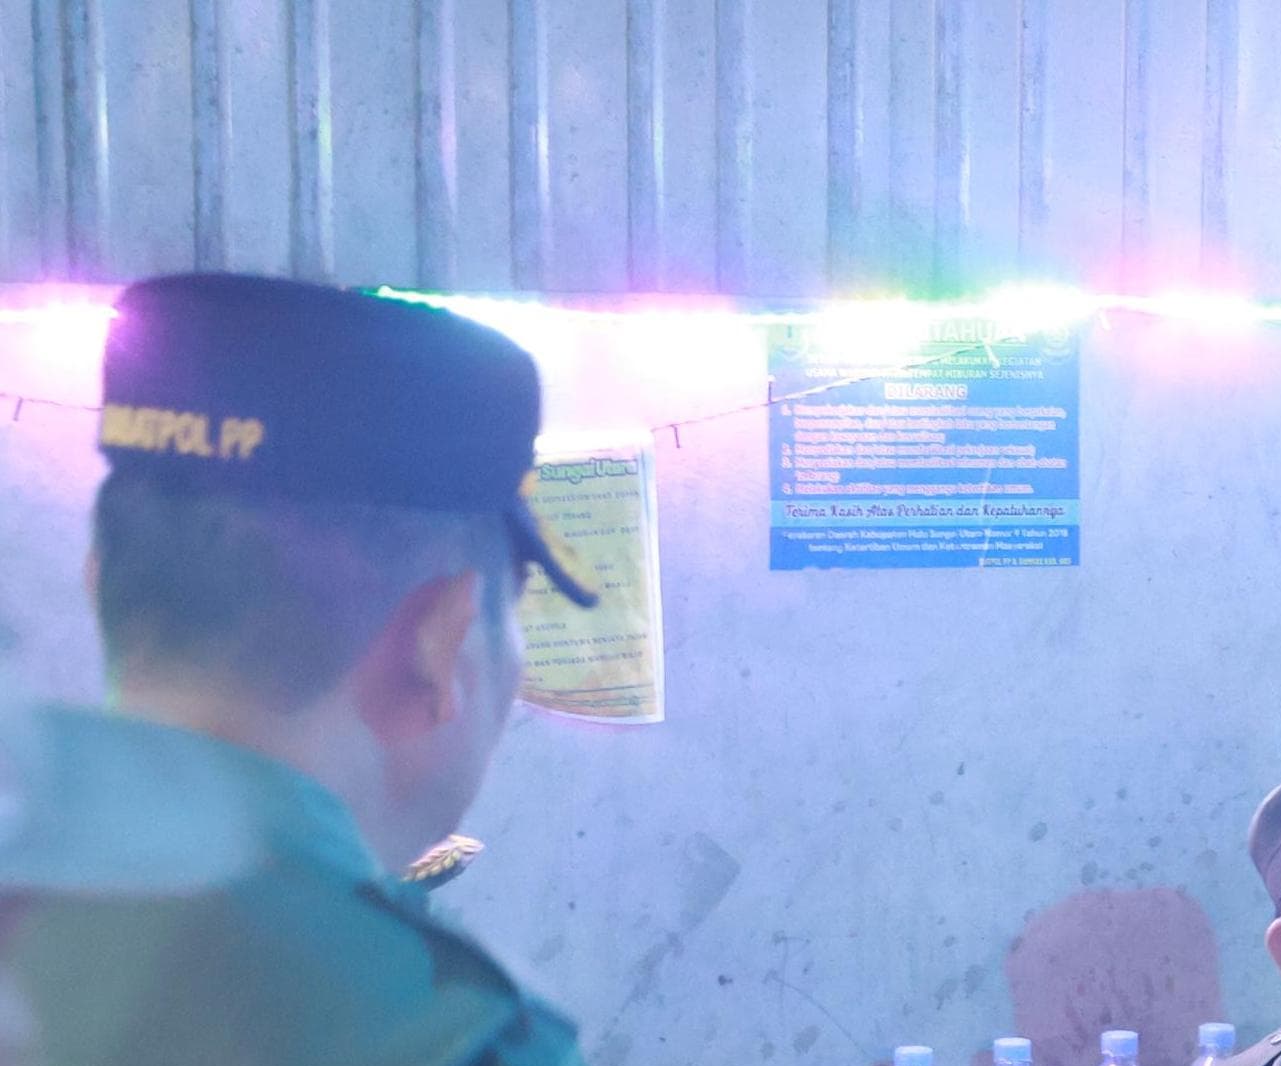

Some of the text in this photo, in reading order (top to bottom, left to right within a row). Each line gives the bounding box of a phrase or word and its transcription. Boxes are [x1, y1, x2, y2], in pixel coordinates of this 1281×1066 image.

[785, 505, 826, 518] Terima
[830, 505, 863, 518] Kasih
[896, 505, 954, 518] Perhatian
[956, 505, 979, 517] dan
